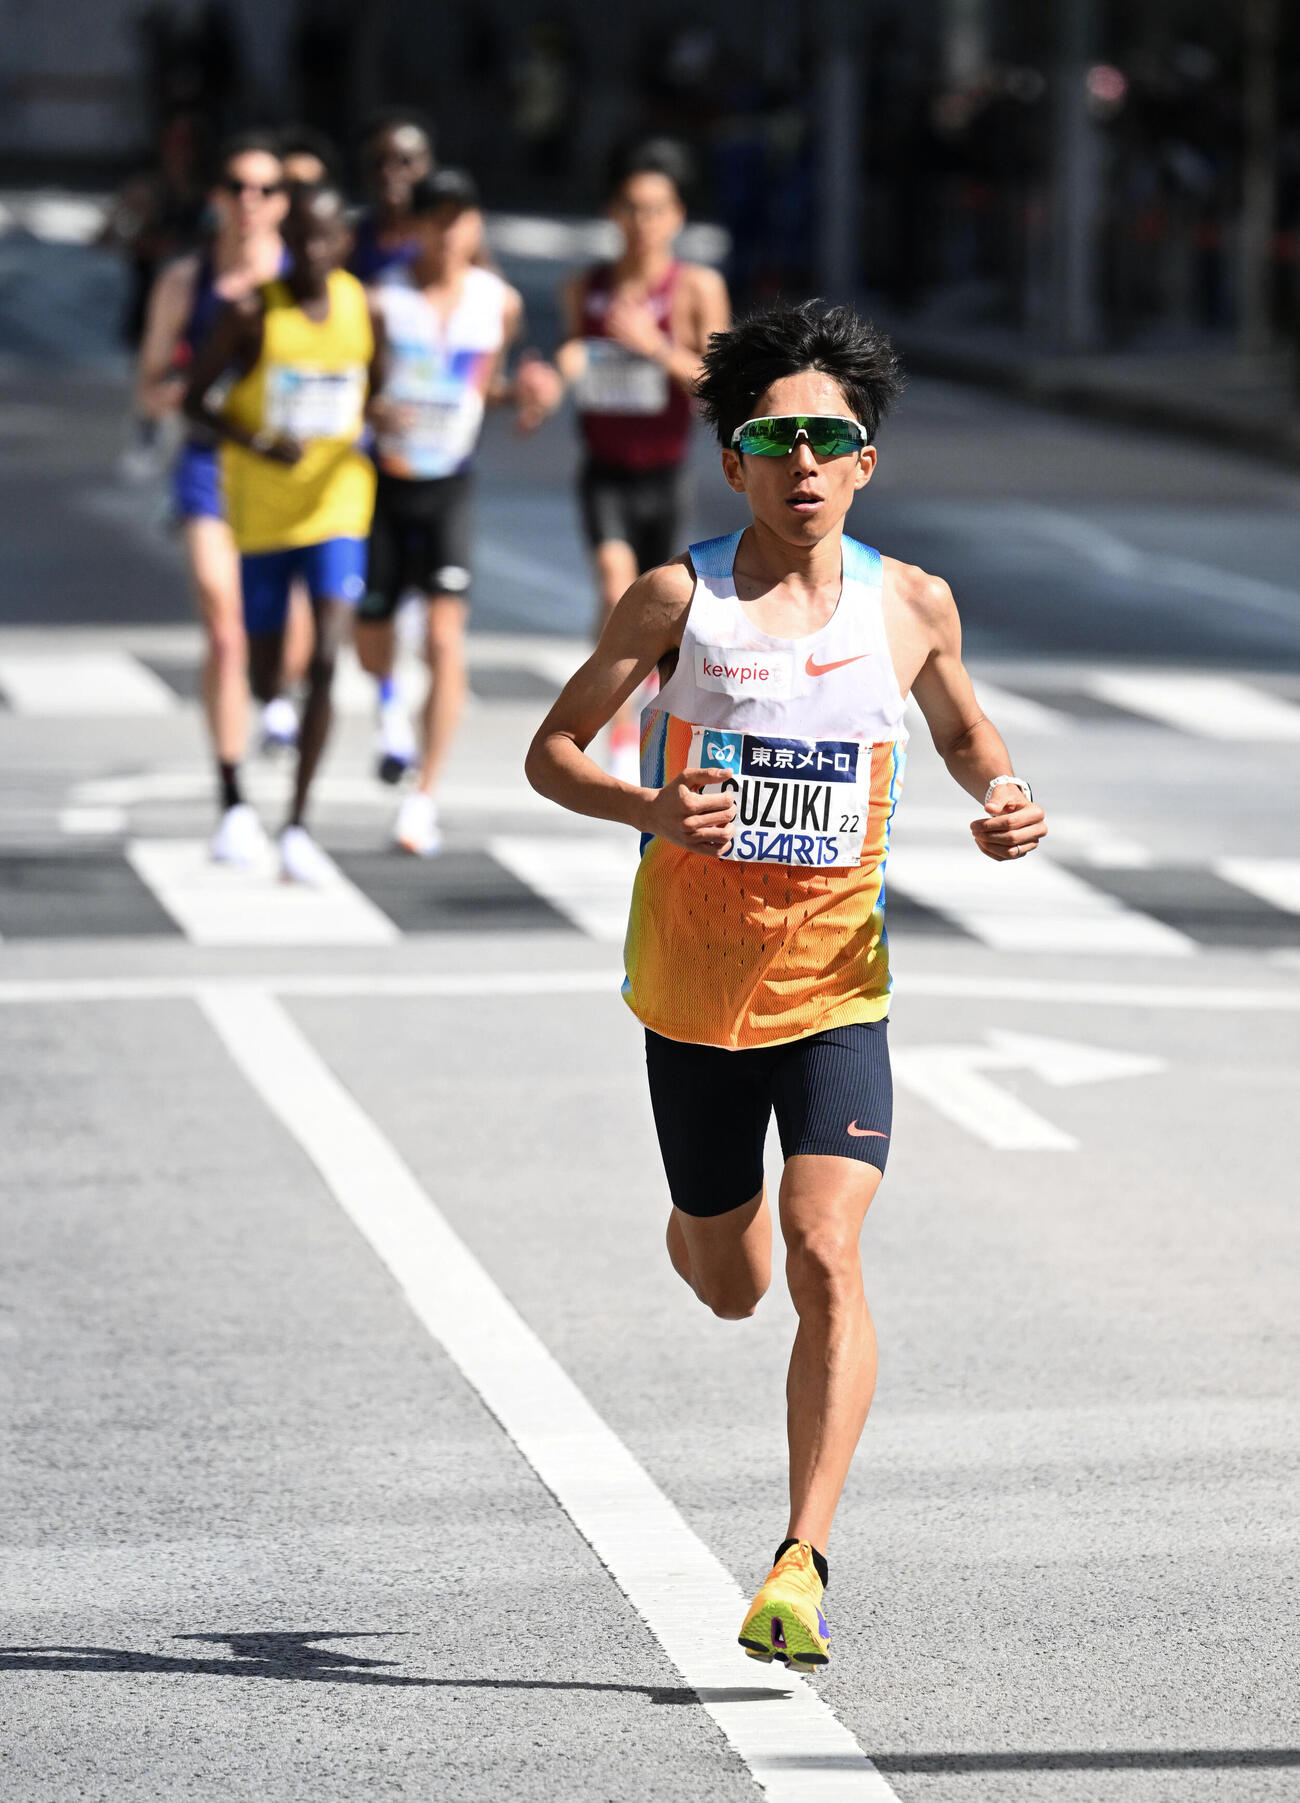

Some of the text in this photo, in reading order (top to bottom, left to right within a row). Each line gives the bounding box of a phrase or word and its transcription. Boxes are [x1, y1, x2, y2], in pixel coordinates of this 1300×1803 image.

[703, 658, 770, 684] kewpie
[750, 747, 850, 772] 東京メトロ
[839, 814, 860, 833] 22
[737, 830, 839, 865] STARTS
